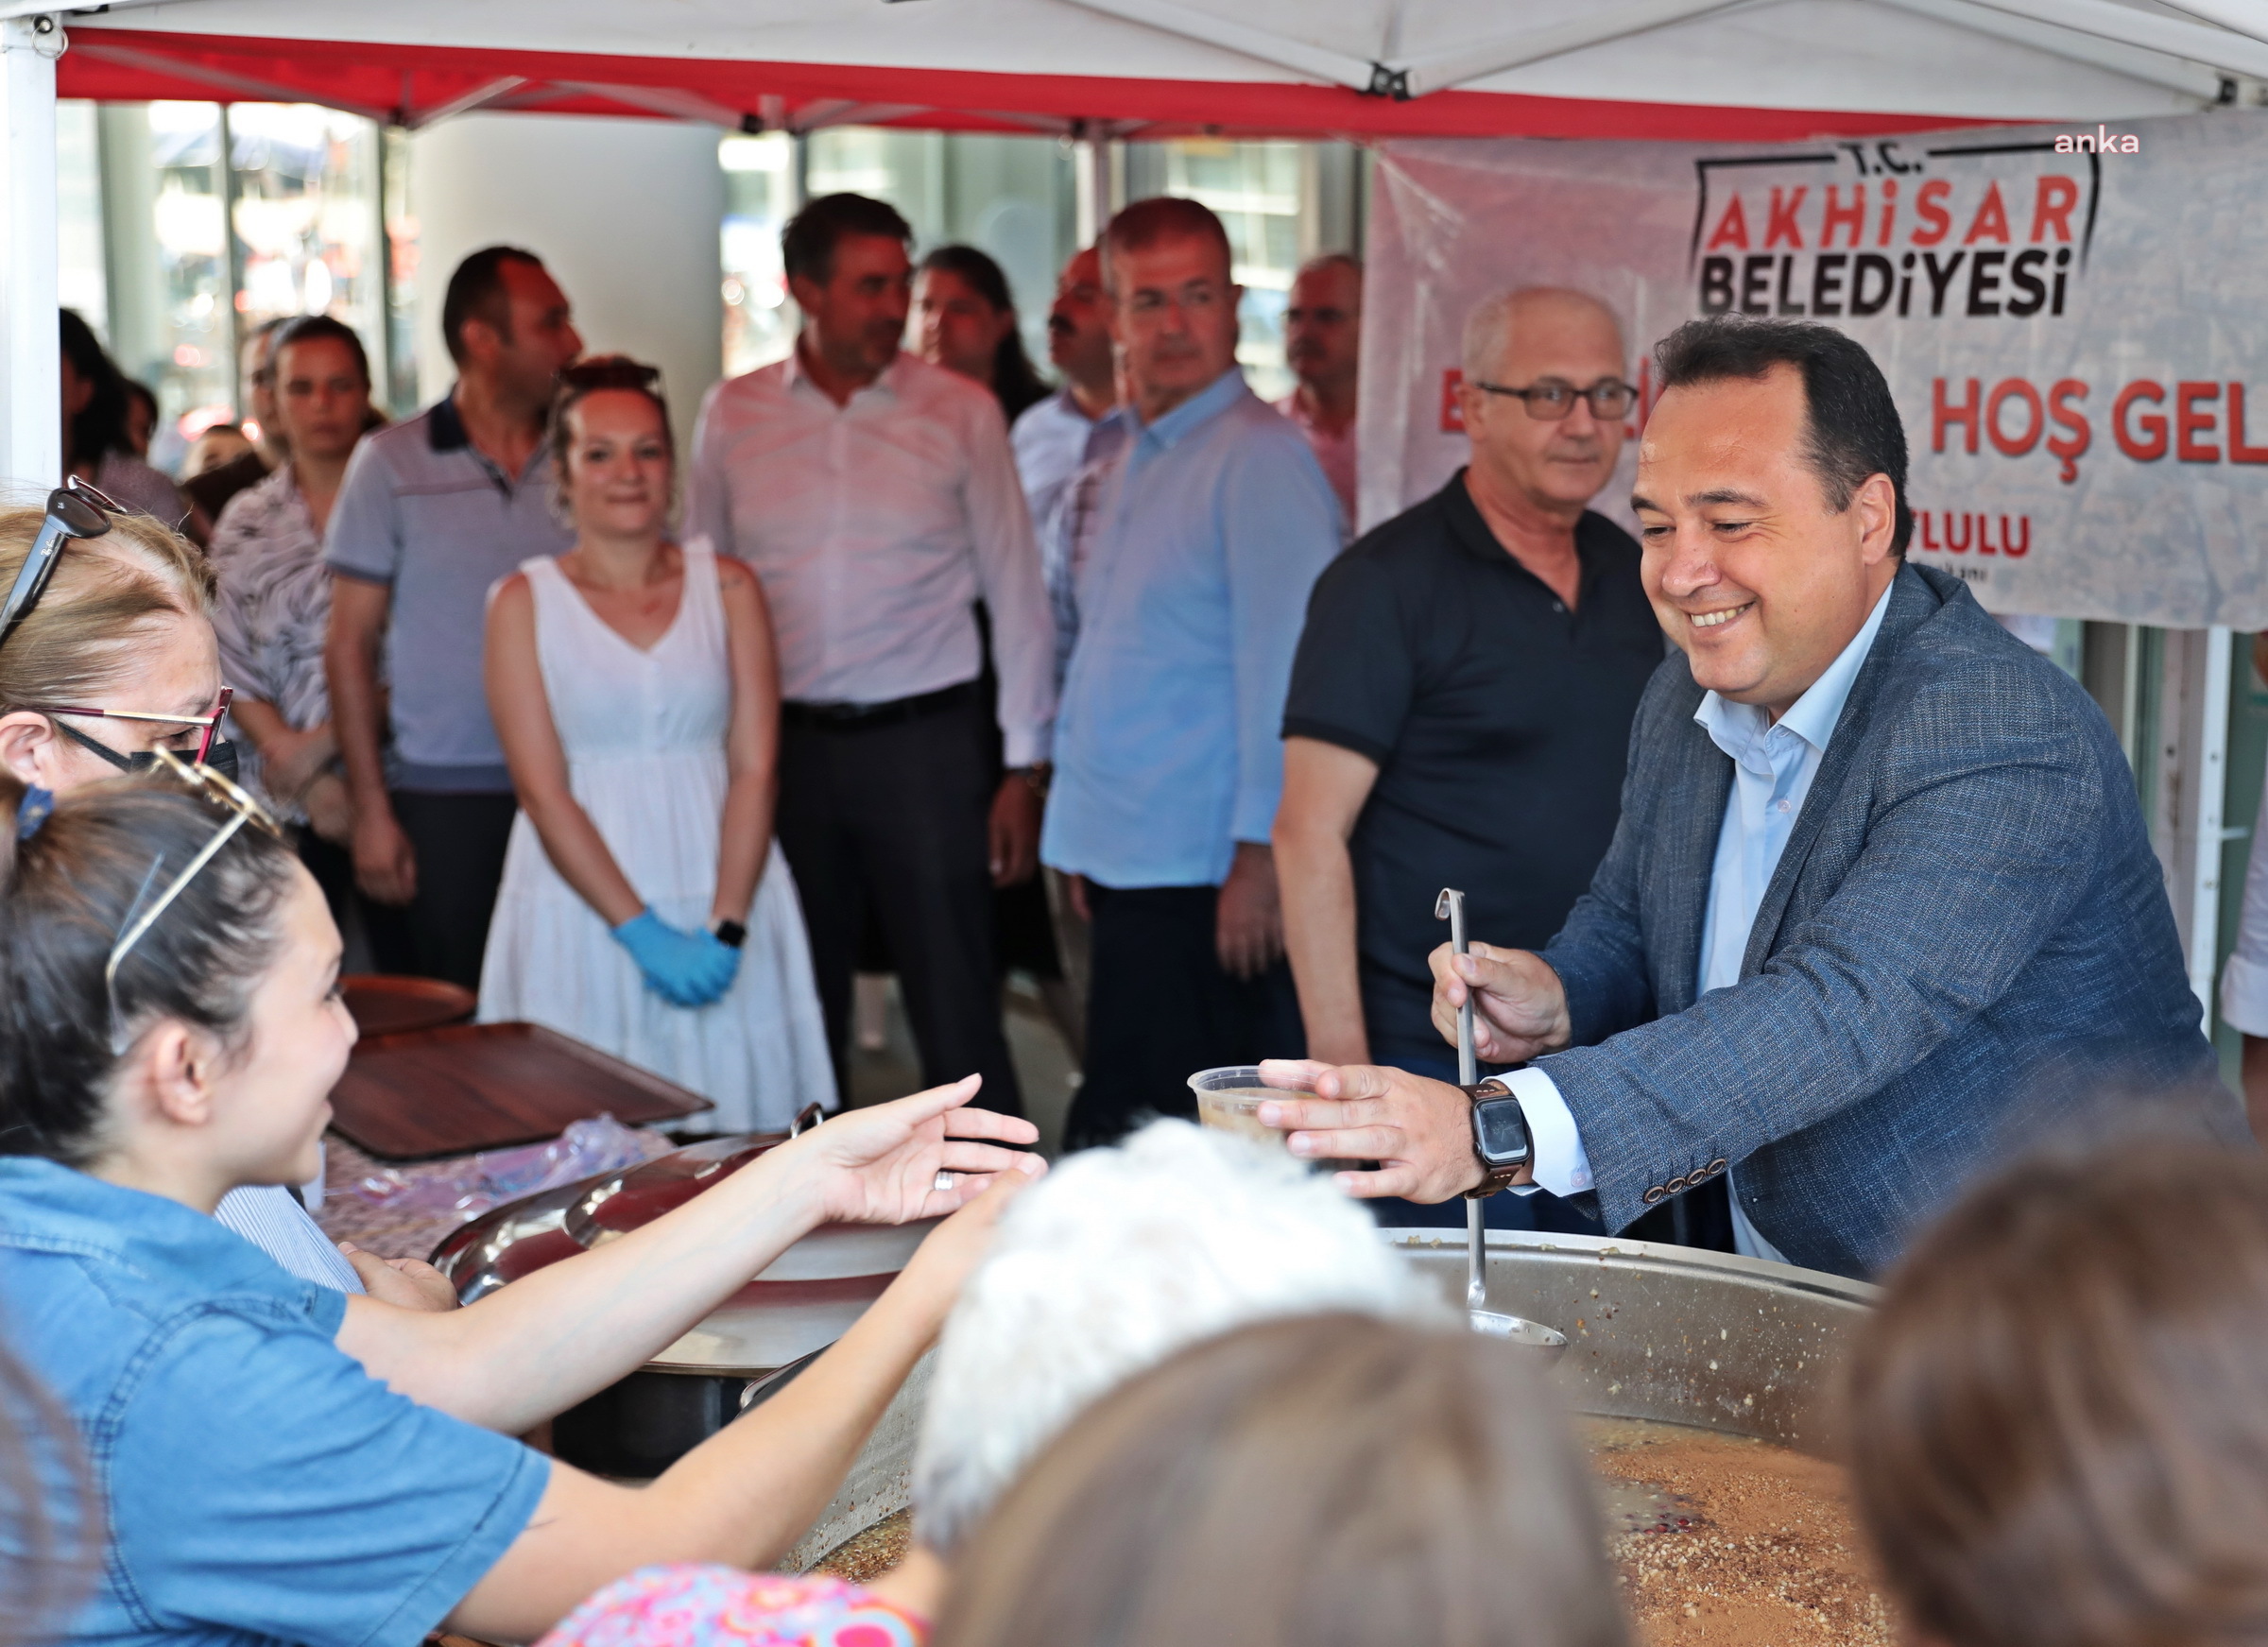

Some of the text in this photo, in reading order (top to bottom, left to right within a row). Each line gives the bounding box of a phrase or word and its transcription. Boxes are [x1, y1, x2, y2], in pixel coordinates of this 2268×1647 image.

[1838, 142, 1923, 176] T.C.
[1932, 377, 2091, 483] HOŞ
[1910, 509, 2031, 558] LULU
